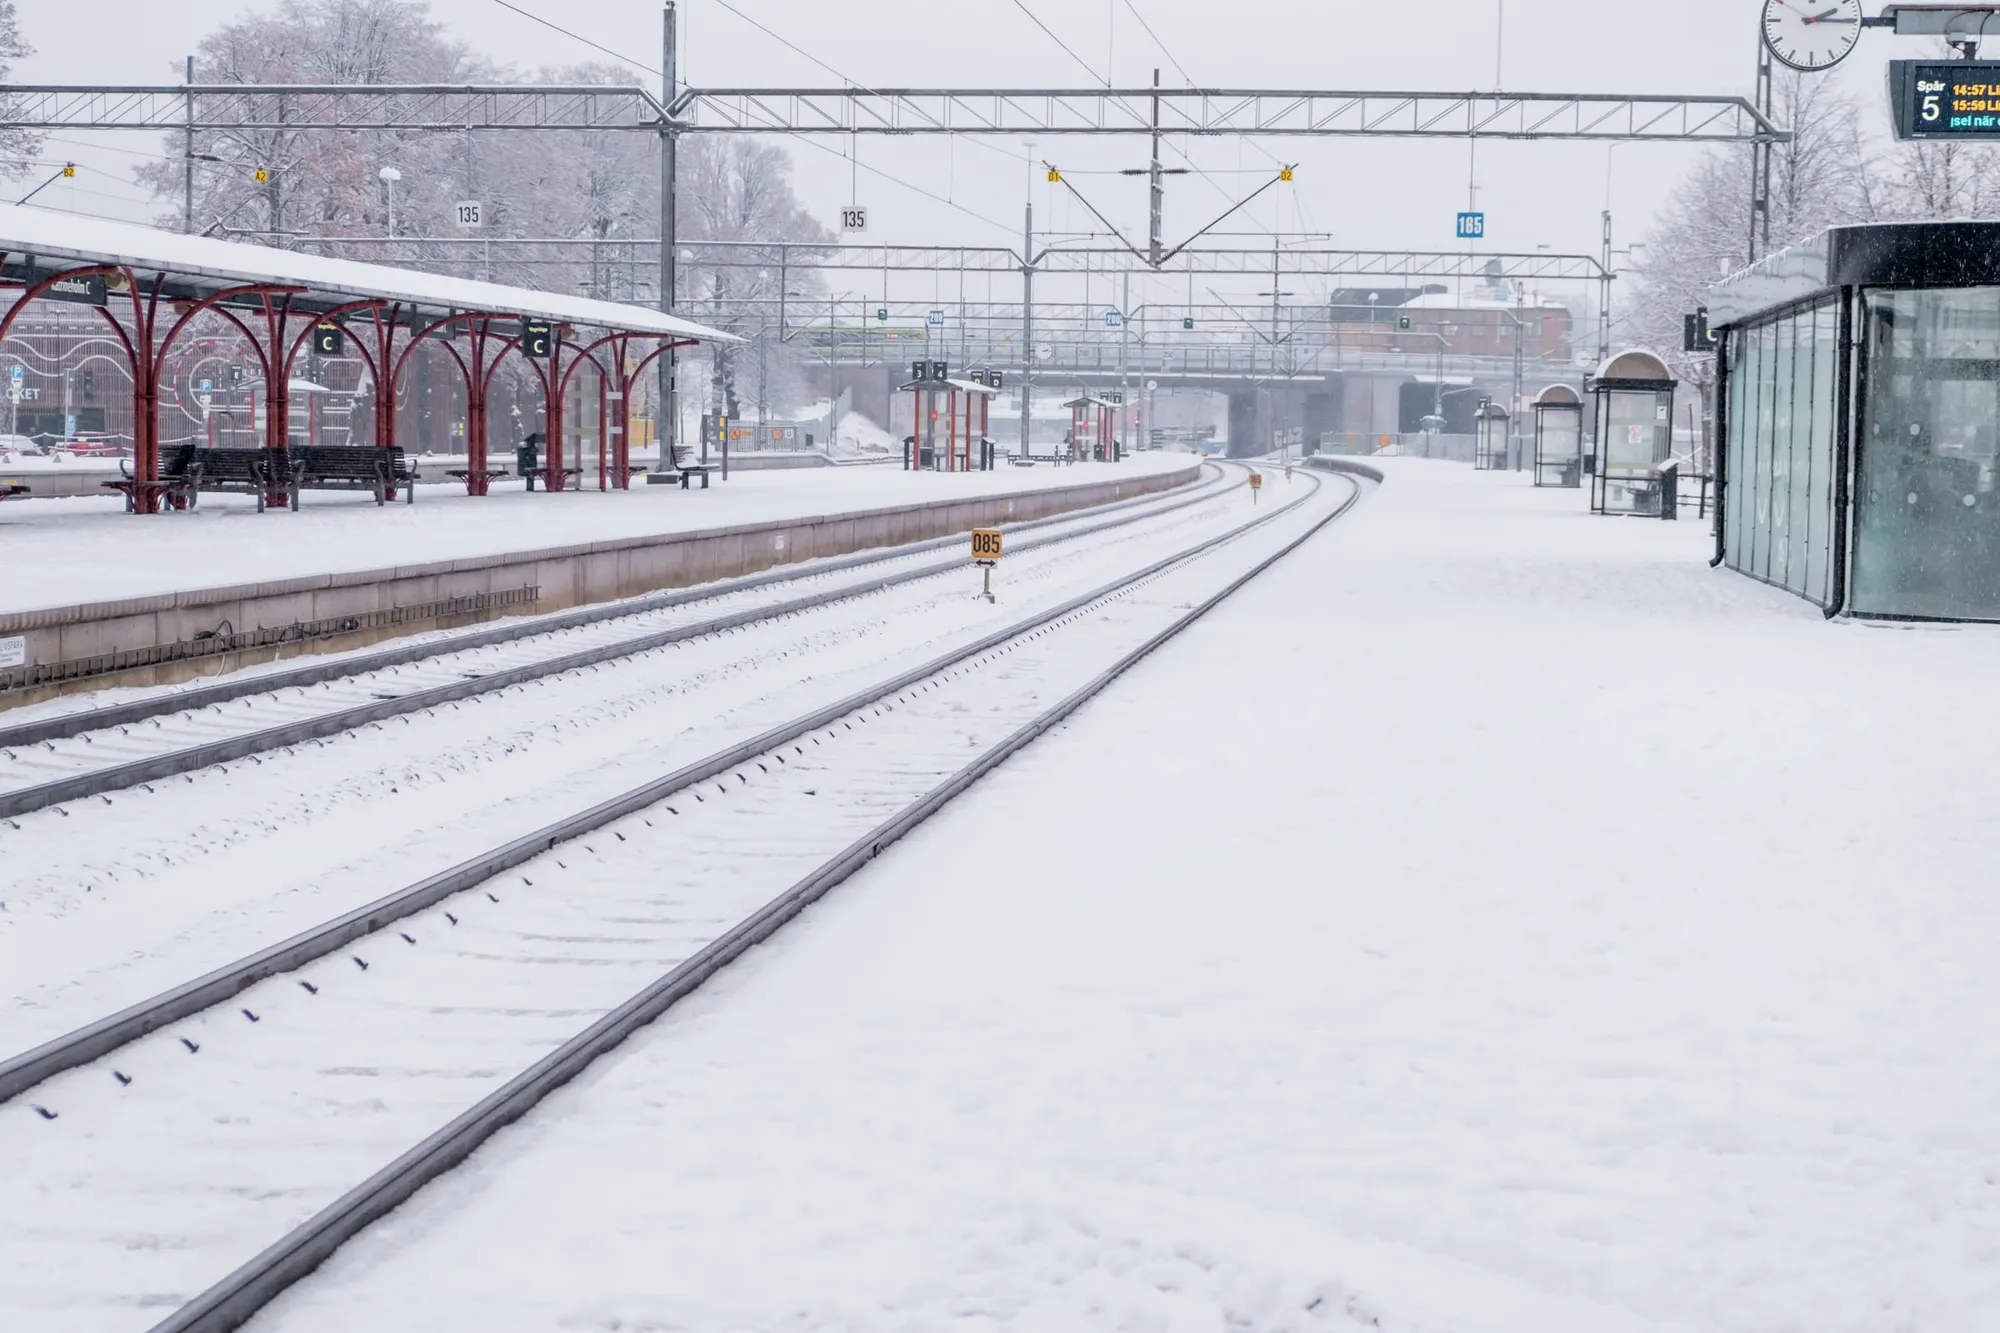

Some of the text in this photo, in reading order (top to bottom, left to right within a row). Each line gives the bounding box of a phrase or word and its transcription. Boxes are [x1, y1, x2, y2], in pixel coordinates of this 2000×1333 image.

[1917, 80, 1946, 93] Spår
[1953, 85, 1987, 95] 14:57
[1922, 96, 1940, 121] 5
[1952, 100, 1986, 111] 15:59
[1974, 115, 1996, 126] när
[458, 206, 478, 223] 135
[842, 211, 864, 228] 135
[323, 336, 333, 351] C
[534, 339, 544, 354] C
[917, 370, 922, 378] 3
[937, 370, 943, 378] 4
[973, 533, 1000, 553] 085
